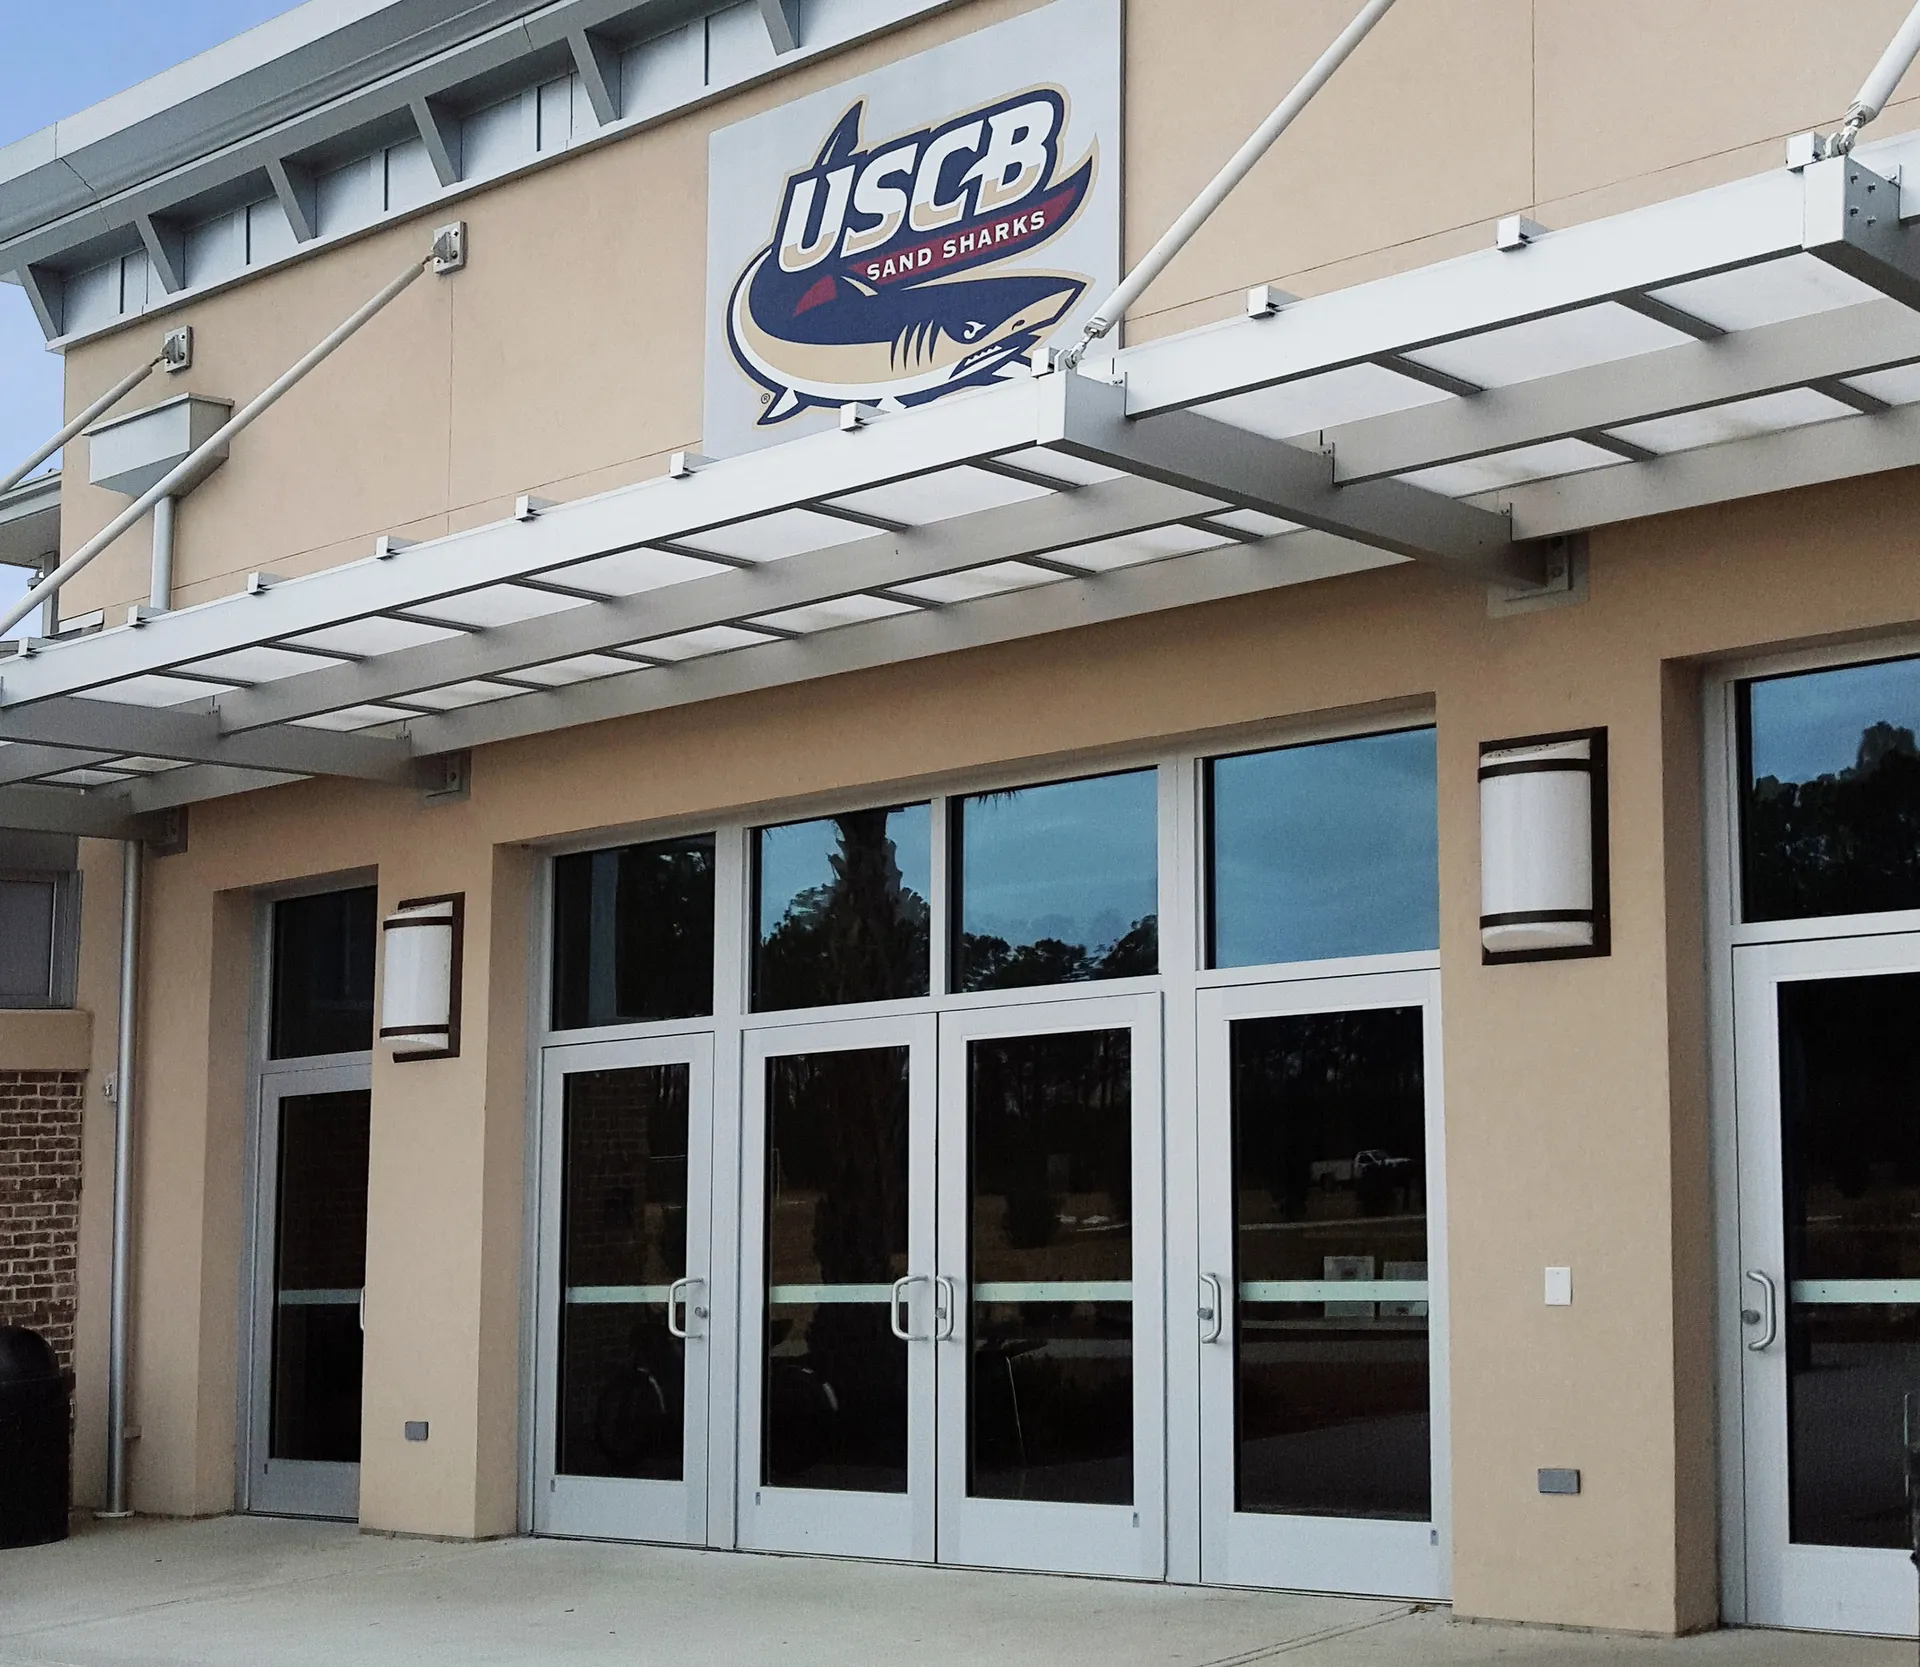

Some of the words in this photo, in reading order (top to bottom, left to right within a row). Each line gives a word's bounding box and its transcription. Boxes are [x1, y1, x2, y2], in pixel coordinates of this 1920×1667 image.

[778, 101, 1054, 272] USCB
[866, 248, 932, 281] SAND
[943, 211, 1045, 258] SHARKS
